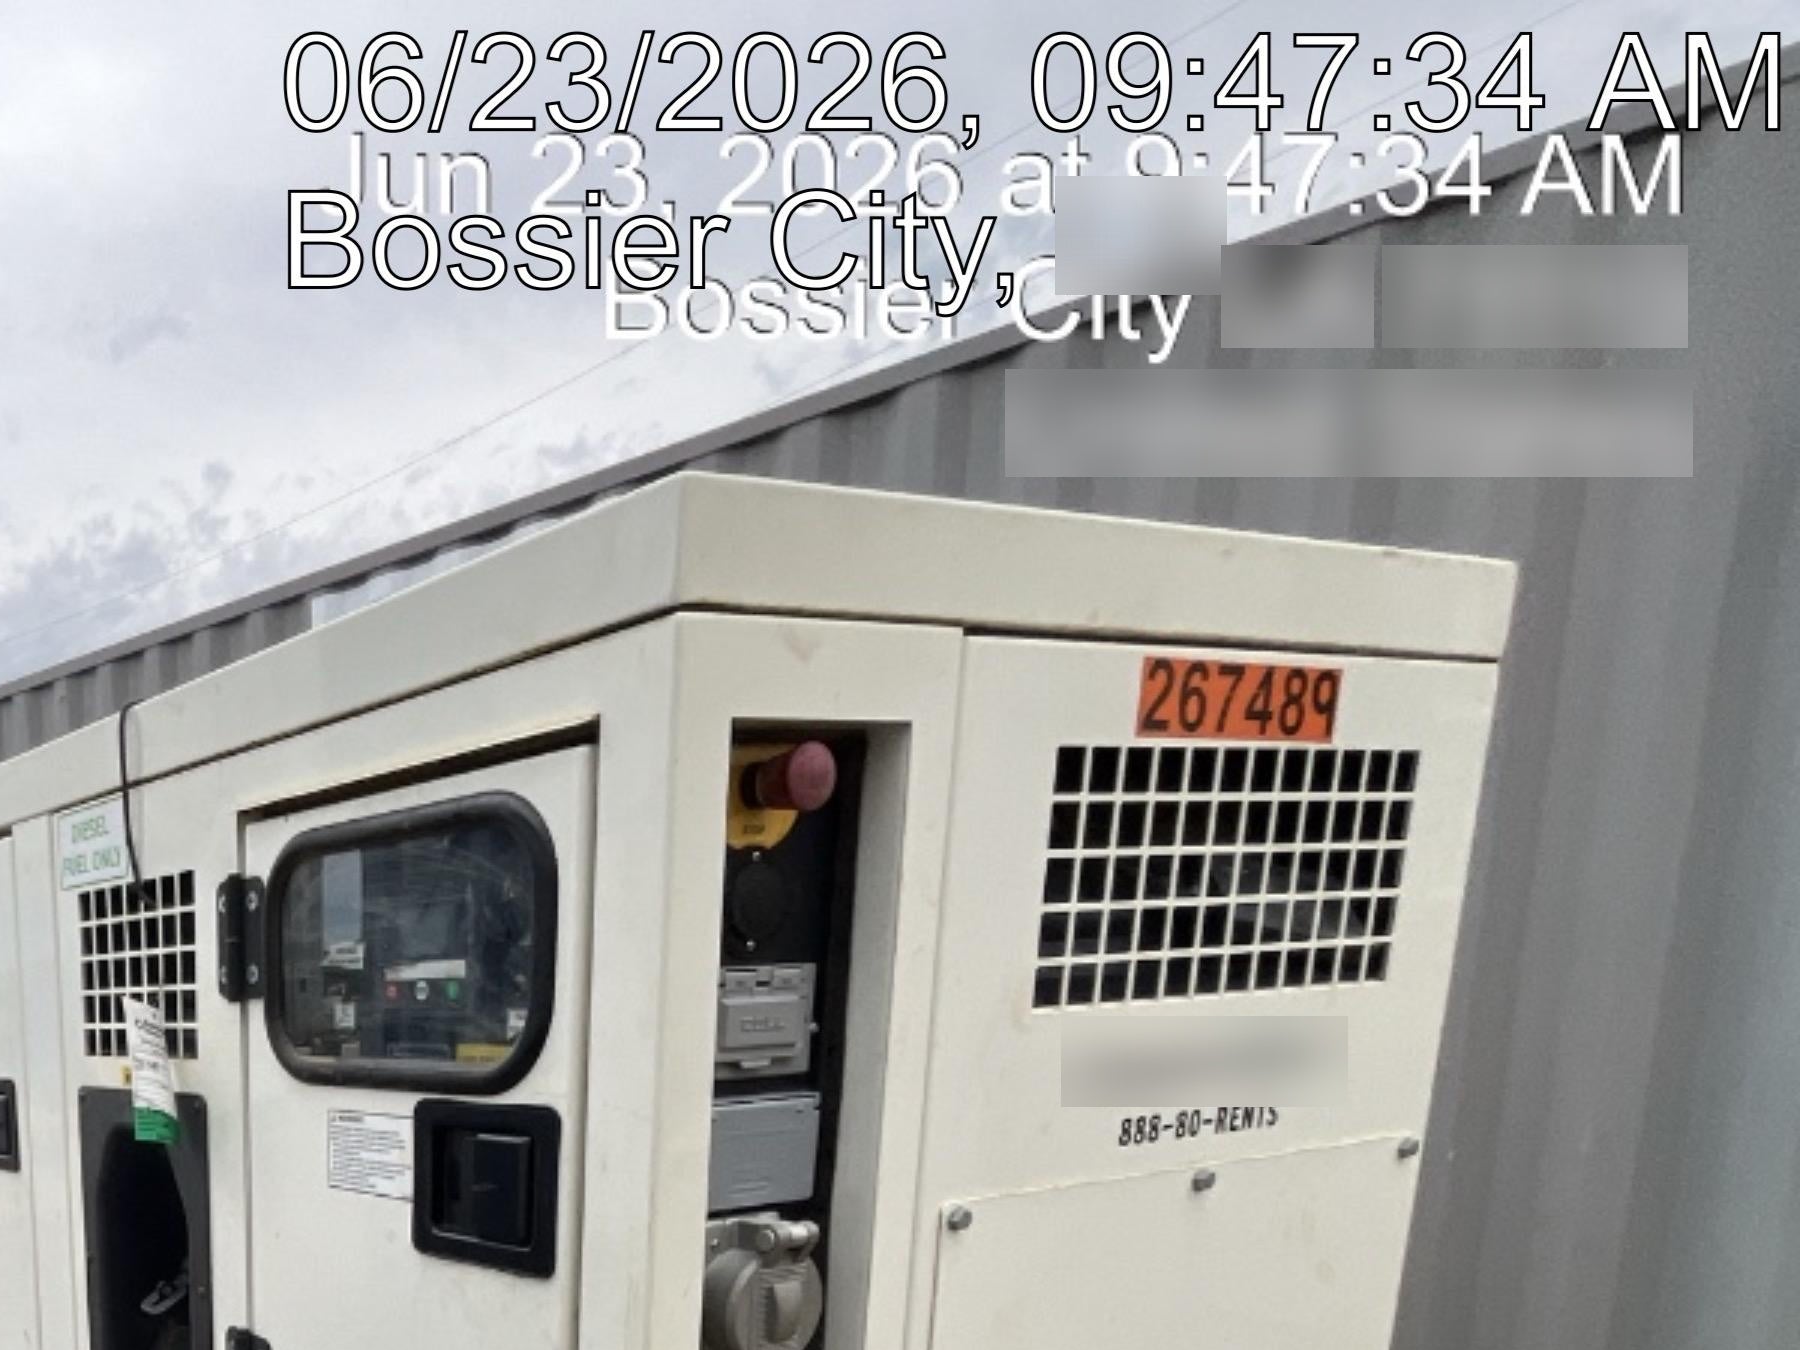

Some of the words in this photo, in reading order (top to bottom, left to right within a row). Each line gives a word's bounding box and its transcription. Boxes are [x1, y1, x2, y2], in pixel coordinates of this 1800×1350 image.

[1143, 658, 1338, 737] 267489
[71, 815, 110, 844] DIESEL
[62, 853, 91, 877] FUEL
[92, 845, 121, 870] ONLY
[1118, 1106, 1279, 1147] 888-80-RENTS
